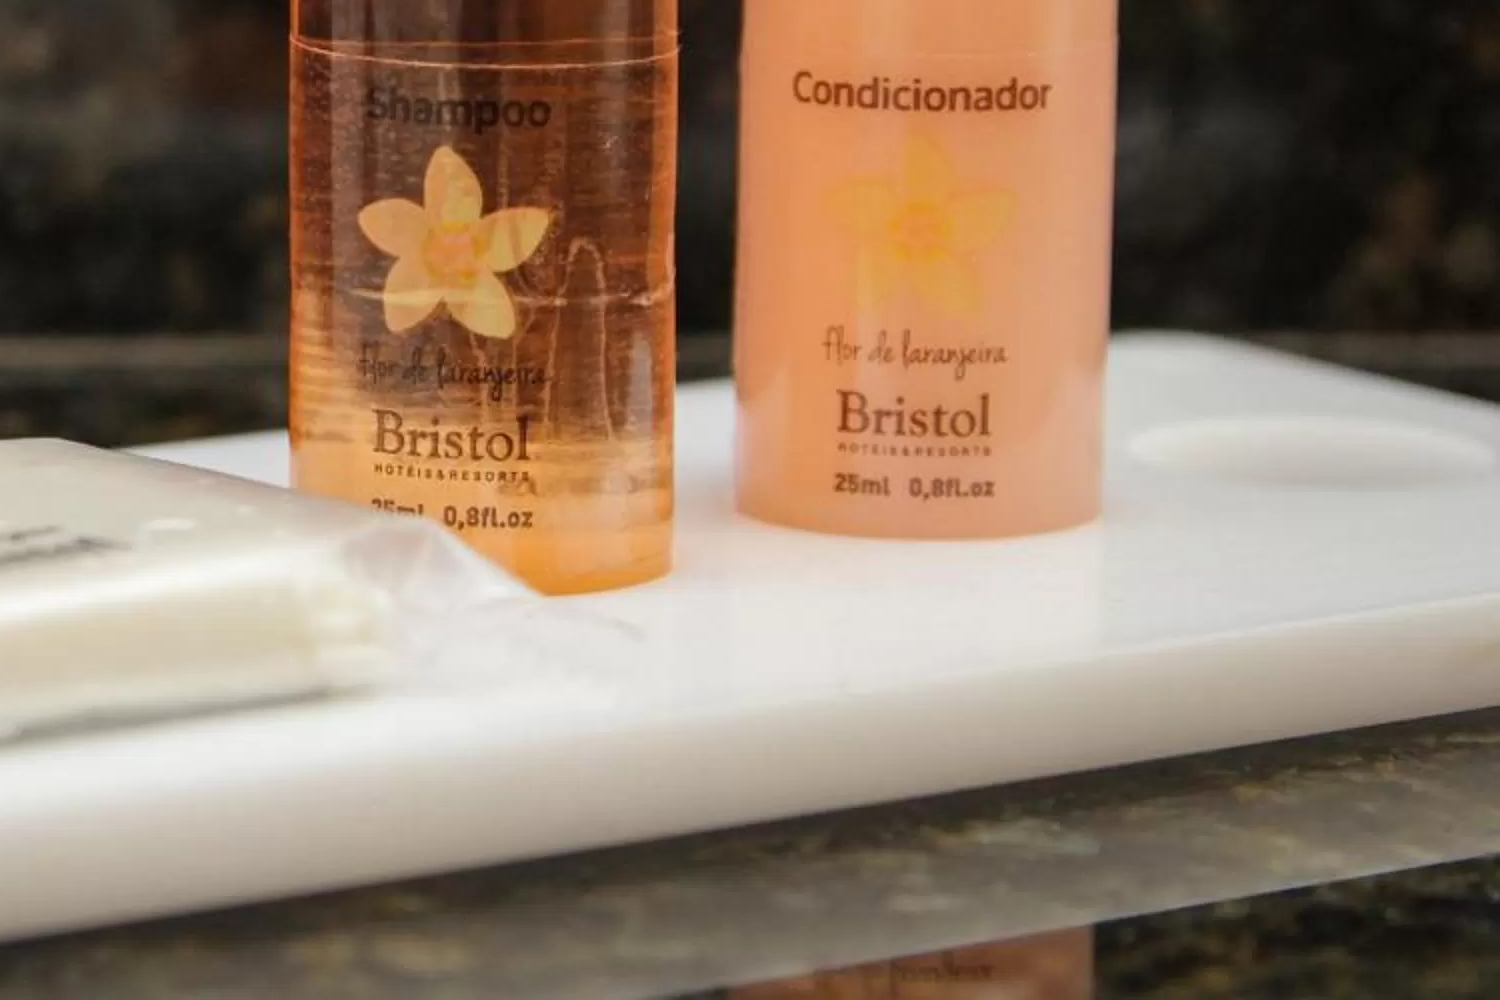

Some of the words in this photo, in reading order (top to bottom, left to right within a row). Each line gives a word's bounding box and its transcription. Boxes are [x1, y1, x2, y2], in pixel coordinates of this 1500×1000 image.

[366, 86, 553, 136] Shampoo
[792, 70, 1053, 113] Condicionador
[371, 408, 532, 463] Bristol
[835, 387, 992, 438] Bristol
[833, 472, 892, 497] 25ml
